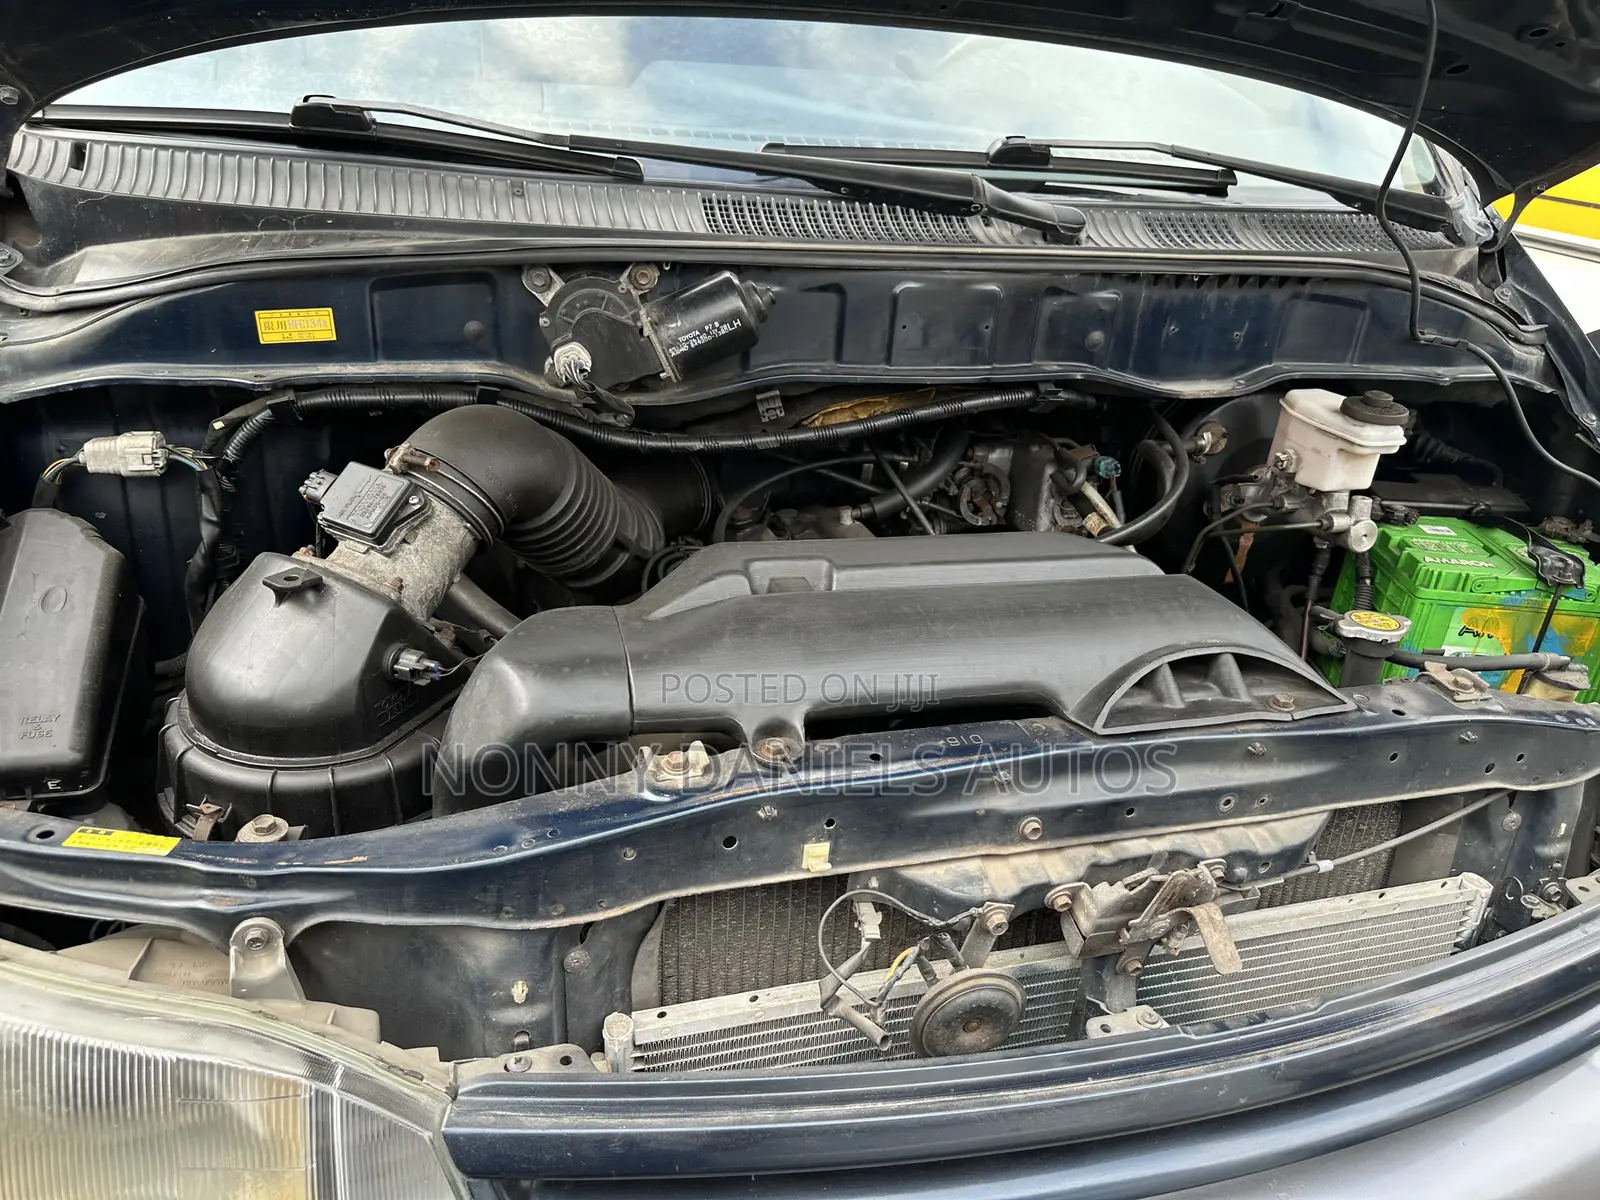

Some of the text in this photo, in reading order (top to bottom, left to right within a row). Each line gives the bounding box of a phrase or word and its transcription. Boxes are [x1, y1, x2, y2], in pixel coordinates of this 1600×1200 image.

[729, 318, 741, 331] LH
[678, 330, 700, 342] TOYOTA
[1424, 556, 1494, 568] AMARON
[20, 714, 61, 725] RELAY
[33, 723, 42, 731] &
[20, 730, 53, 740] FUSE
